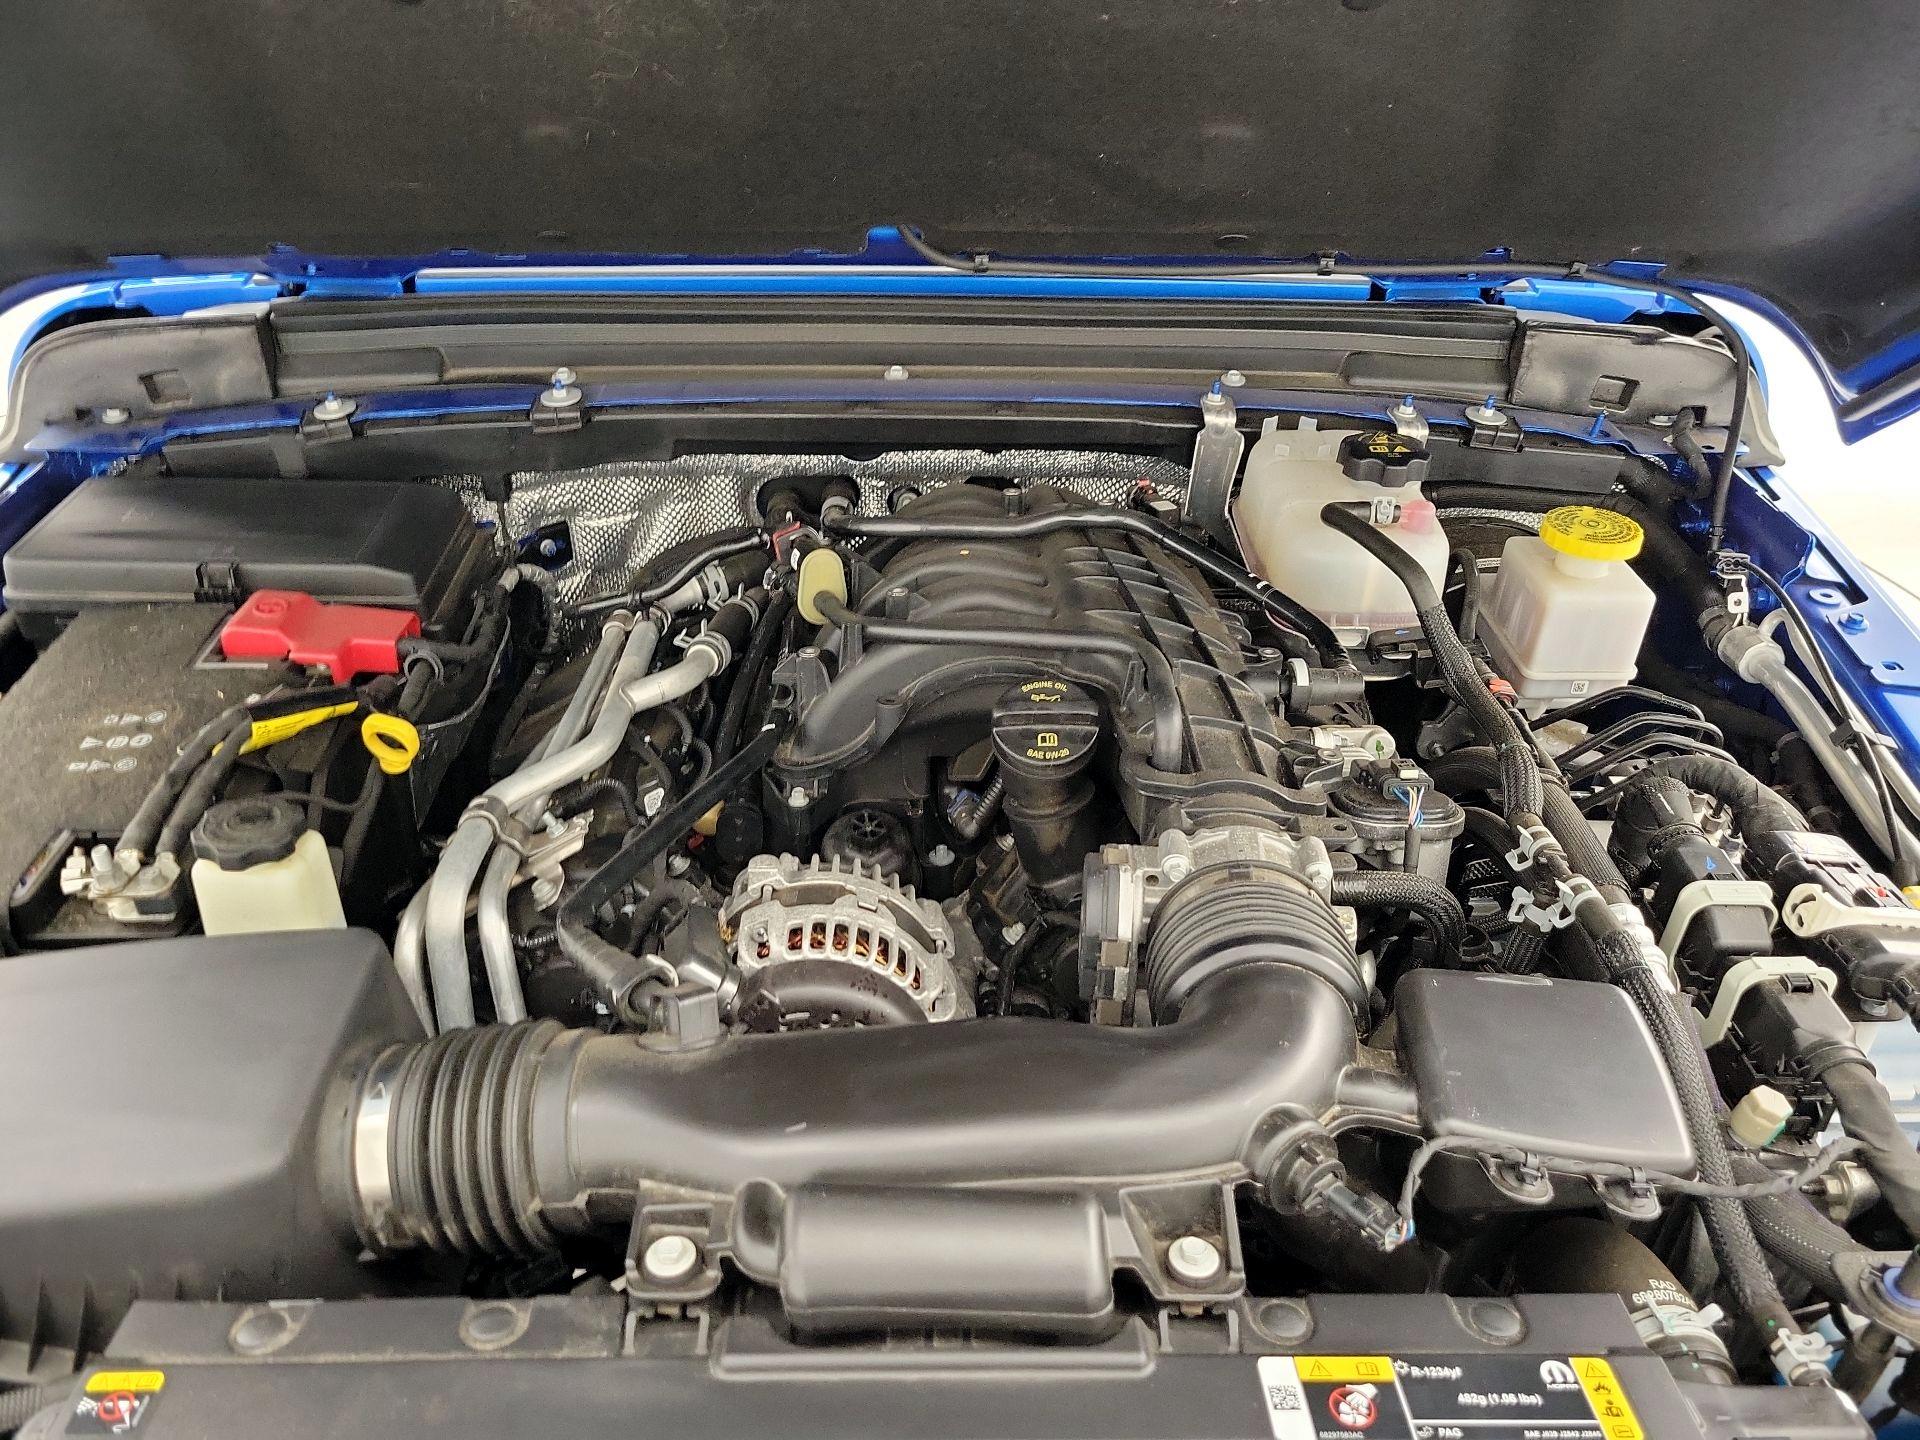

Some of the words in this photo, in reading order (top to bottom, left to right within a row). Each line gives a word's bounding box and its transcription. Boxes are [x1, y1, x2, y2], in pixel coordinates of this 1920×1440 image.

[1021, 680, 1053, 693] ENGINE
[1054, 681, 1068, 693] OIL
[1045, 747, 1070, 760] 0W-20
[1648, 1278, 1677, 1291] RAD
[1410, 1366, 1462, 1380] R-1234yf
[1546, 1383, 1580, 1391] MOPAR
[1437, 1426, 1464, 1438] PAG
